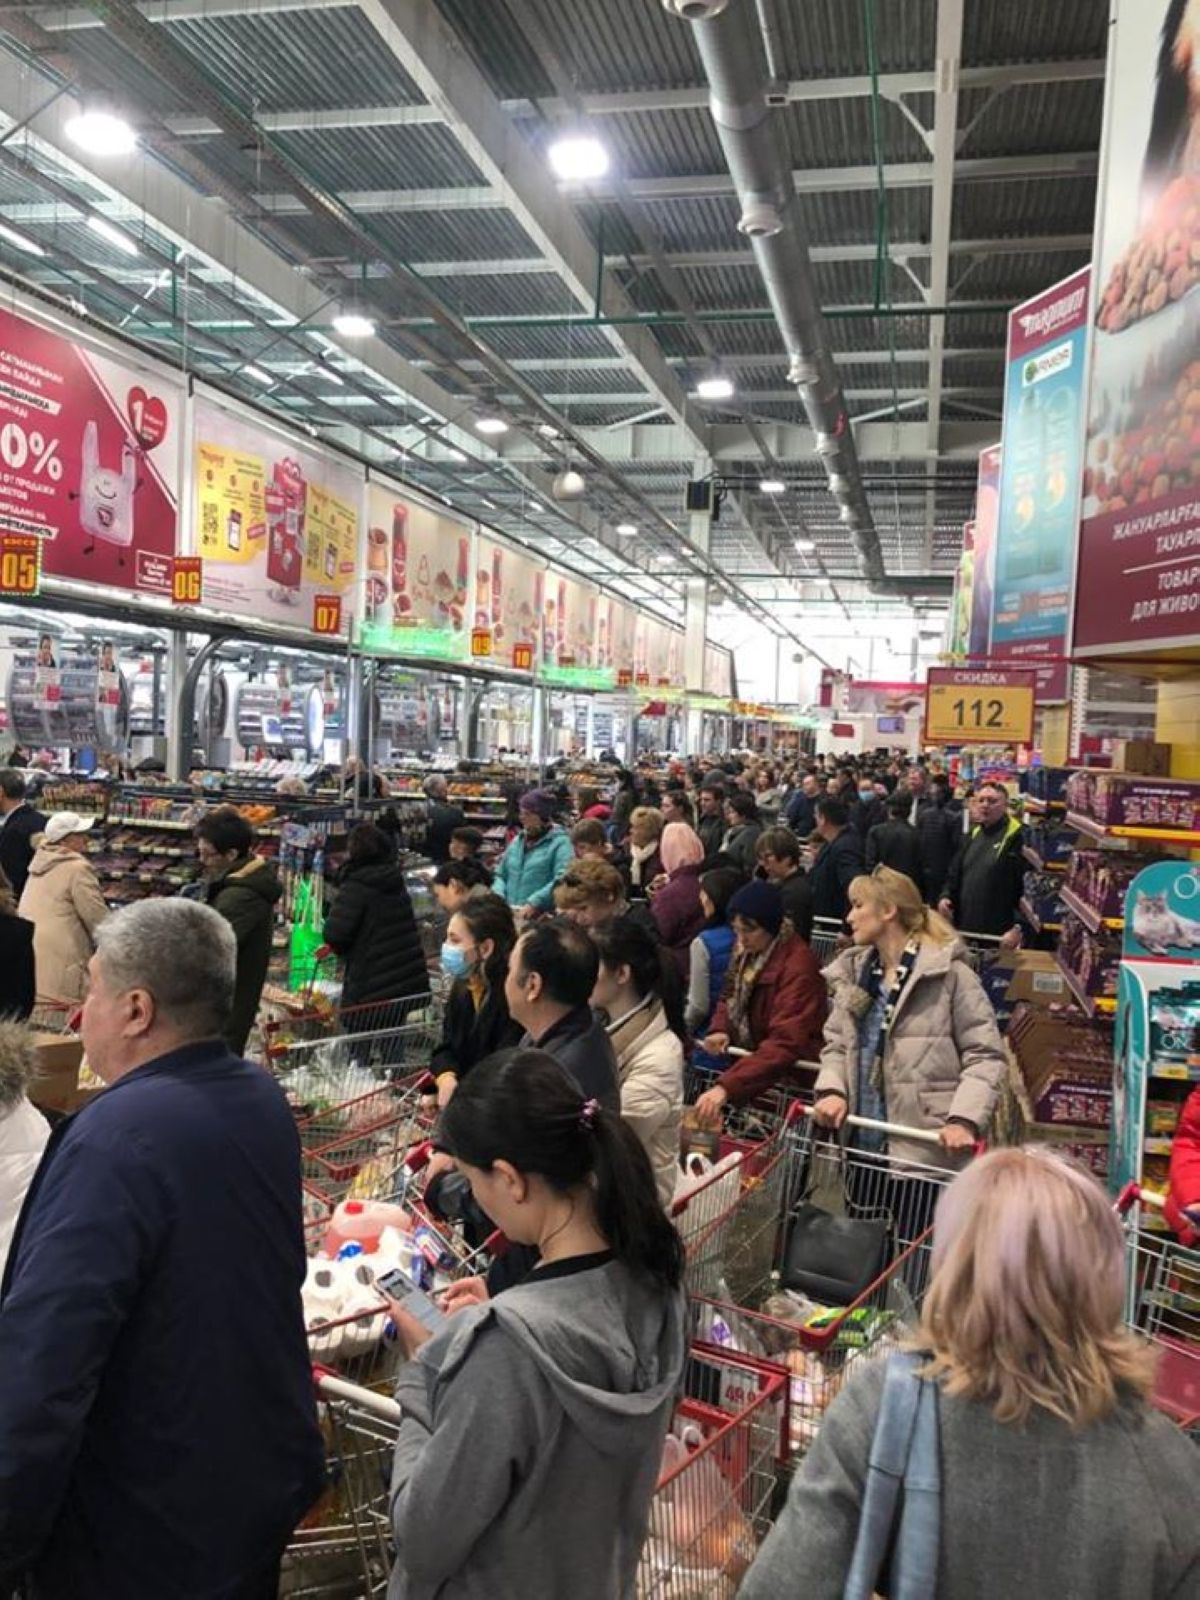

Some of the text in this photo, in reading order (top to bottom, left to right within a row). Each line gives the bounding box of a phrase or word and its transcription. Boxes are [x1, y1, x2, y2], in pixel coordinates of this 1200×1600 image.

[2, 552, 35, 590] 05
[174, 570, 201, 600] 06
[1158, 566, 1200, 591] ТОВАР
[316, 606, 338, 631] 07
[1130, 592, 1200, 623] ДЛЯ ЖИВО
[954, 671, 1008, 684] СКИДКА
[953, 697, 1004, 728] 112
